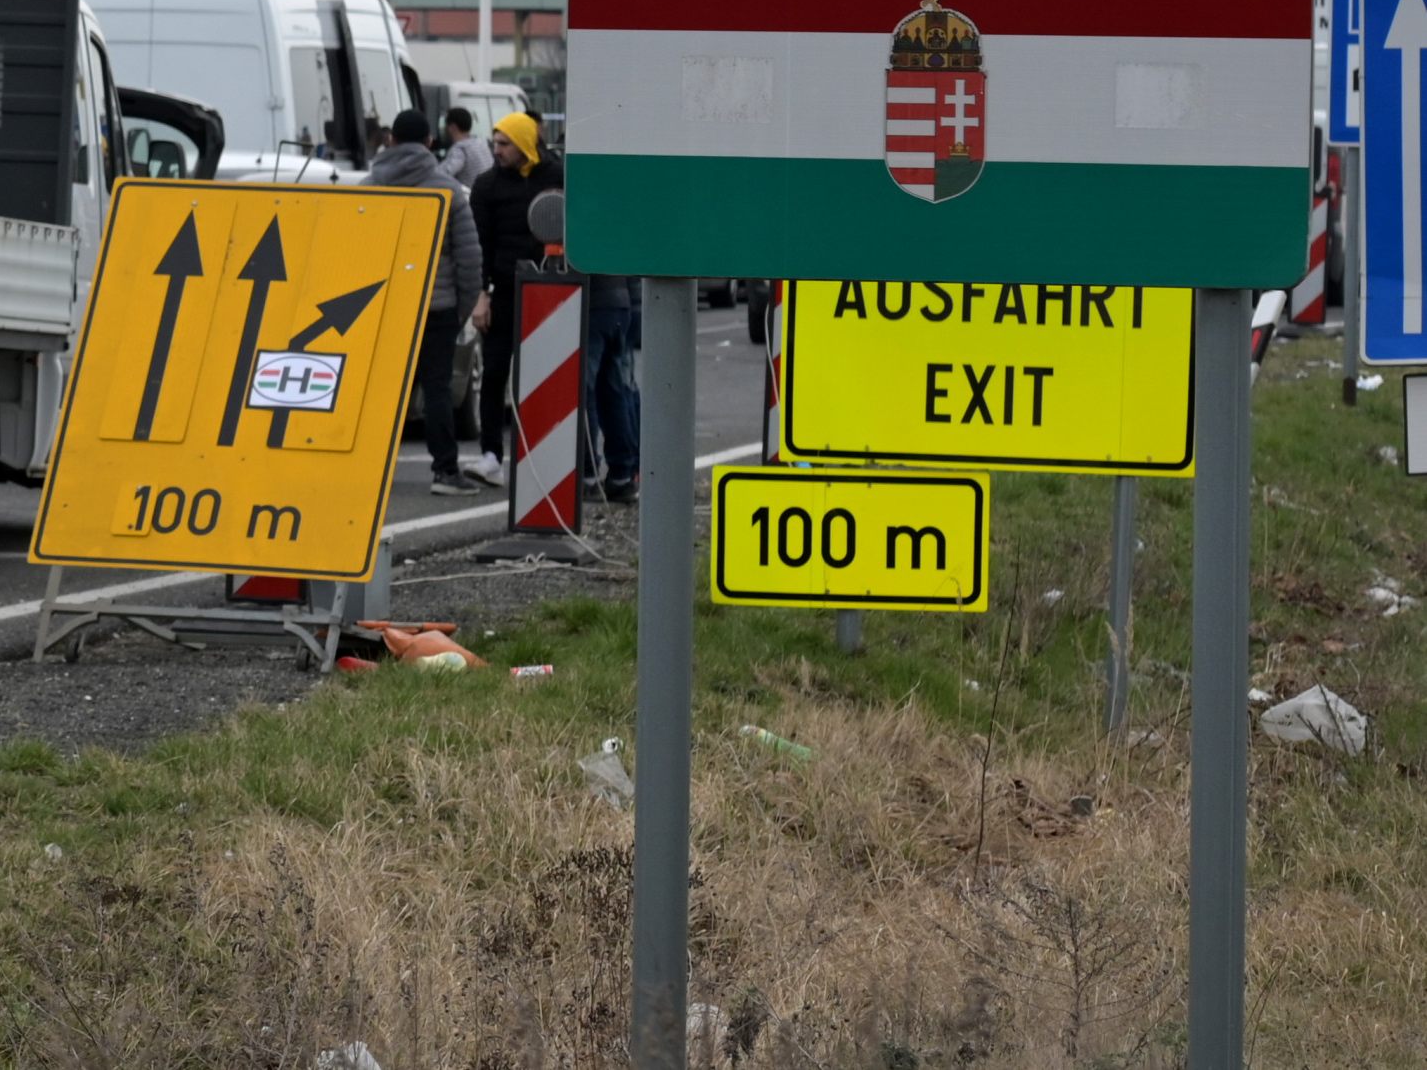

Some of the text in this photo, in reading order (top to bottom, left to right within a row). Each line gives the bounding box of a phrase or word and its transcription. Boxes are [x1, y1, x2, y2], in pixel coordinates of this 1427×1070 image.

[277, 366, 312, 394] H
[925, 363, 1054, 426] EXIT
[134, 486, 301, 541] 100 m
[752, 506, 946, 570] 100 m
